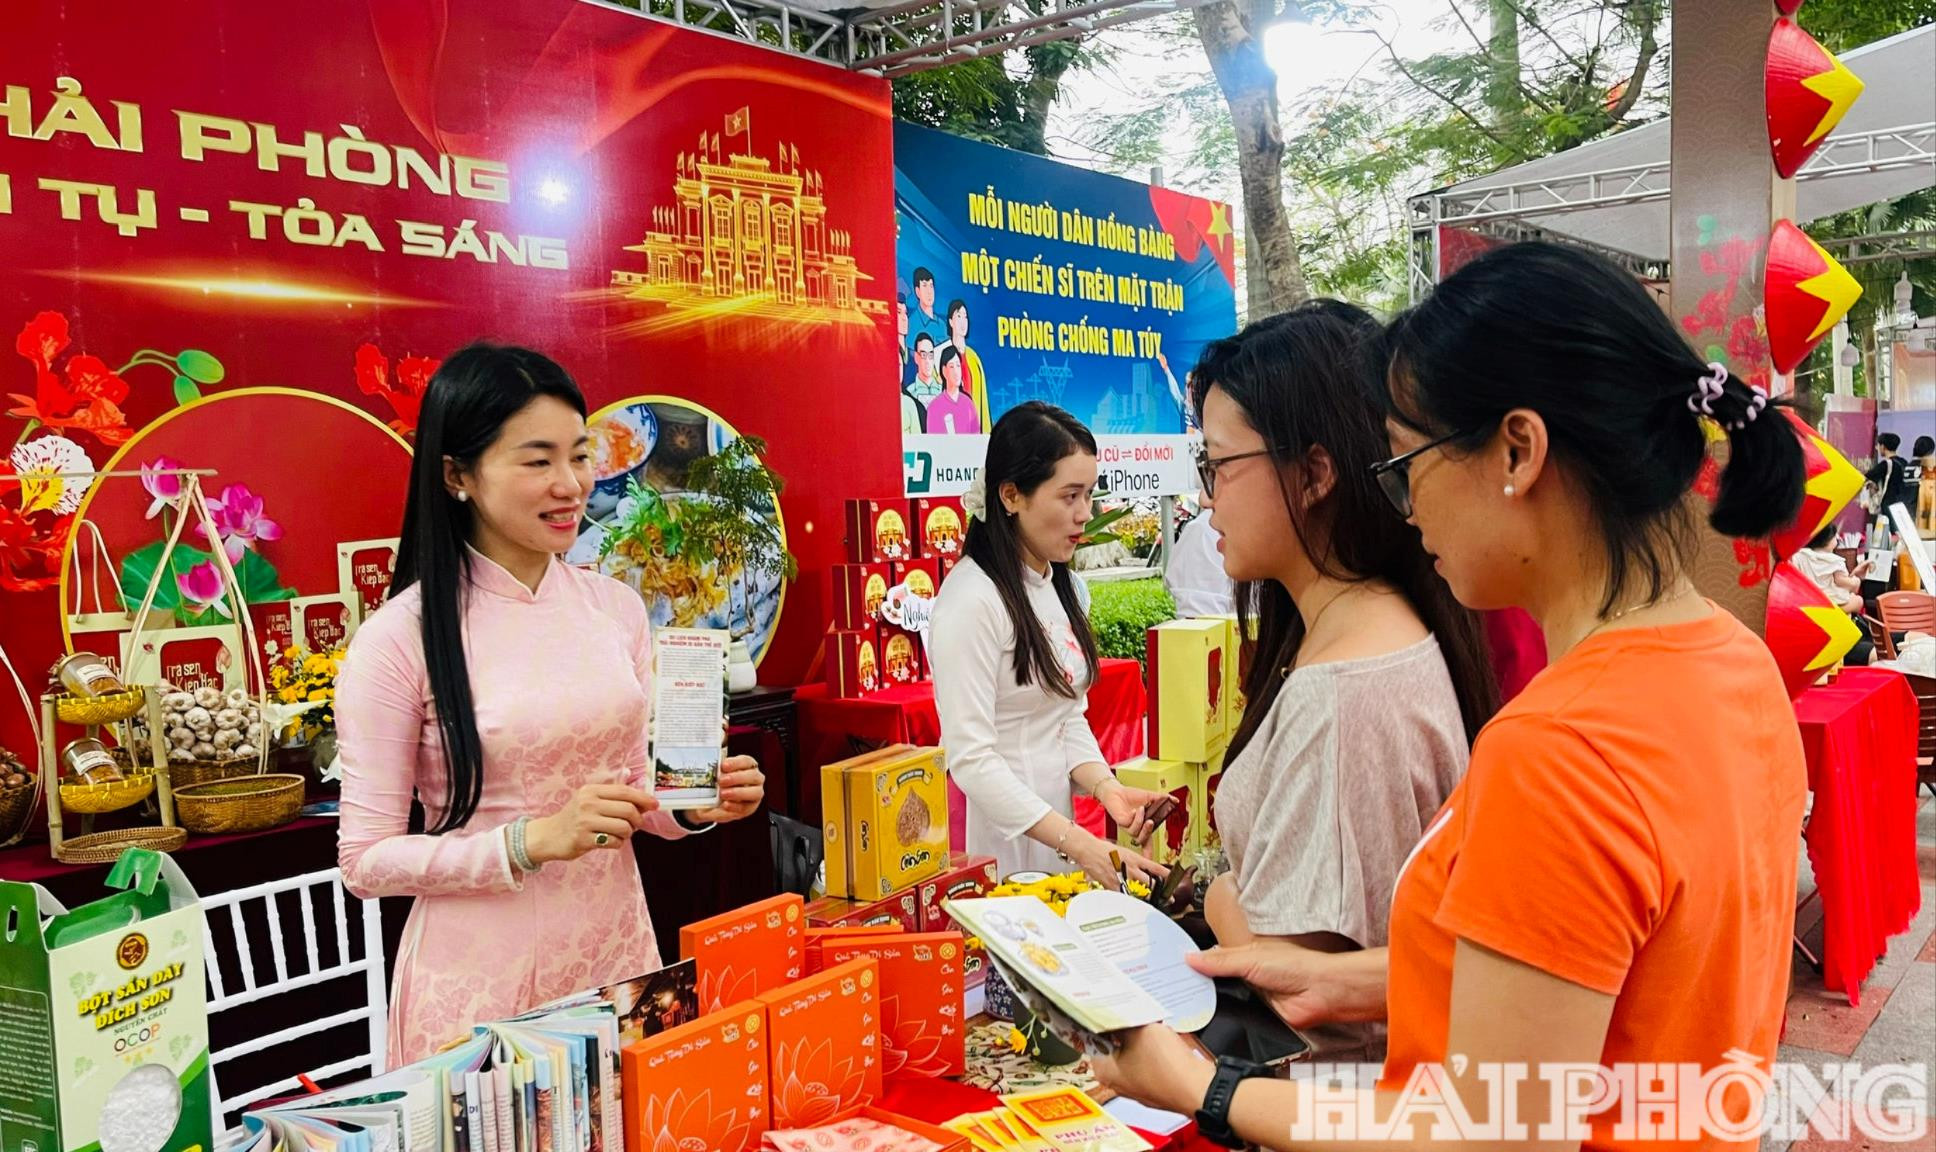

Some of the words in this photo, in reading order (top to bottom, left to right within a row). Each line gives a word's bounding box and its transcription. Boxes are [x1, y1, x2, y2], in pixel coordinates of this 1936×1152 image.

[170, 109, 510, 203] PHÒNG
[38, 177, 157, 236] TỤ
[228, 198, 385, 252] TỎA
[396, 219, 568, 270] SÁNG
[968, 185, 1004, 230] MỖI
[1008, 201, 1059, 240] NGƯỜI
[1062, 208, 1094, 246] DÂN
[1097, 212, 1136, 253] HỒNG
[1139, 224, 1175, 261] BÀNG
[961, 248, 999, 294] MỘT
[1004, 254, 1054, 295] CHIẾN
[1058, 263, 1074, 298] SĨ
[1077, 267, 1114, 303] TRÊN
[1117, 272, 1147, 312] MẶT
[1150, 278, 1184, 316] TRẬN
[997, 311, 1054, 352] PHÒNG
[1058, 315, 1109, 355] CHỐNG
[1112, 329, 1136, 356] MA
[1137, 326, 1162, 359] TÚY
[1111, 469, 1160, 492] iPhone
[78, 990, 113, 1017] BỘT
[114, 1023, 160, 1052] OCOP
